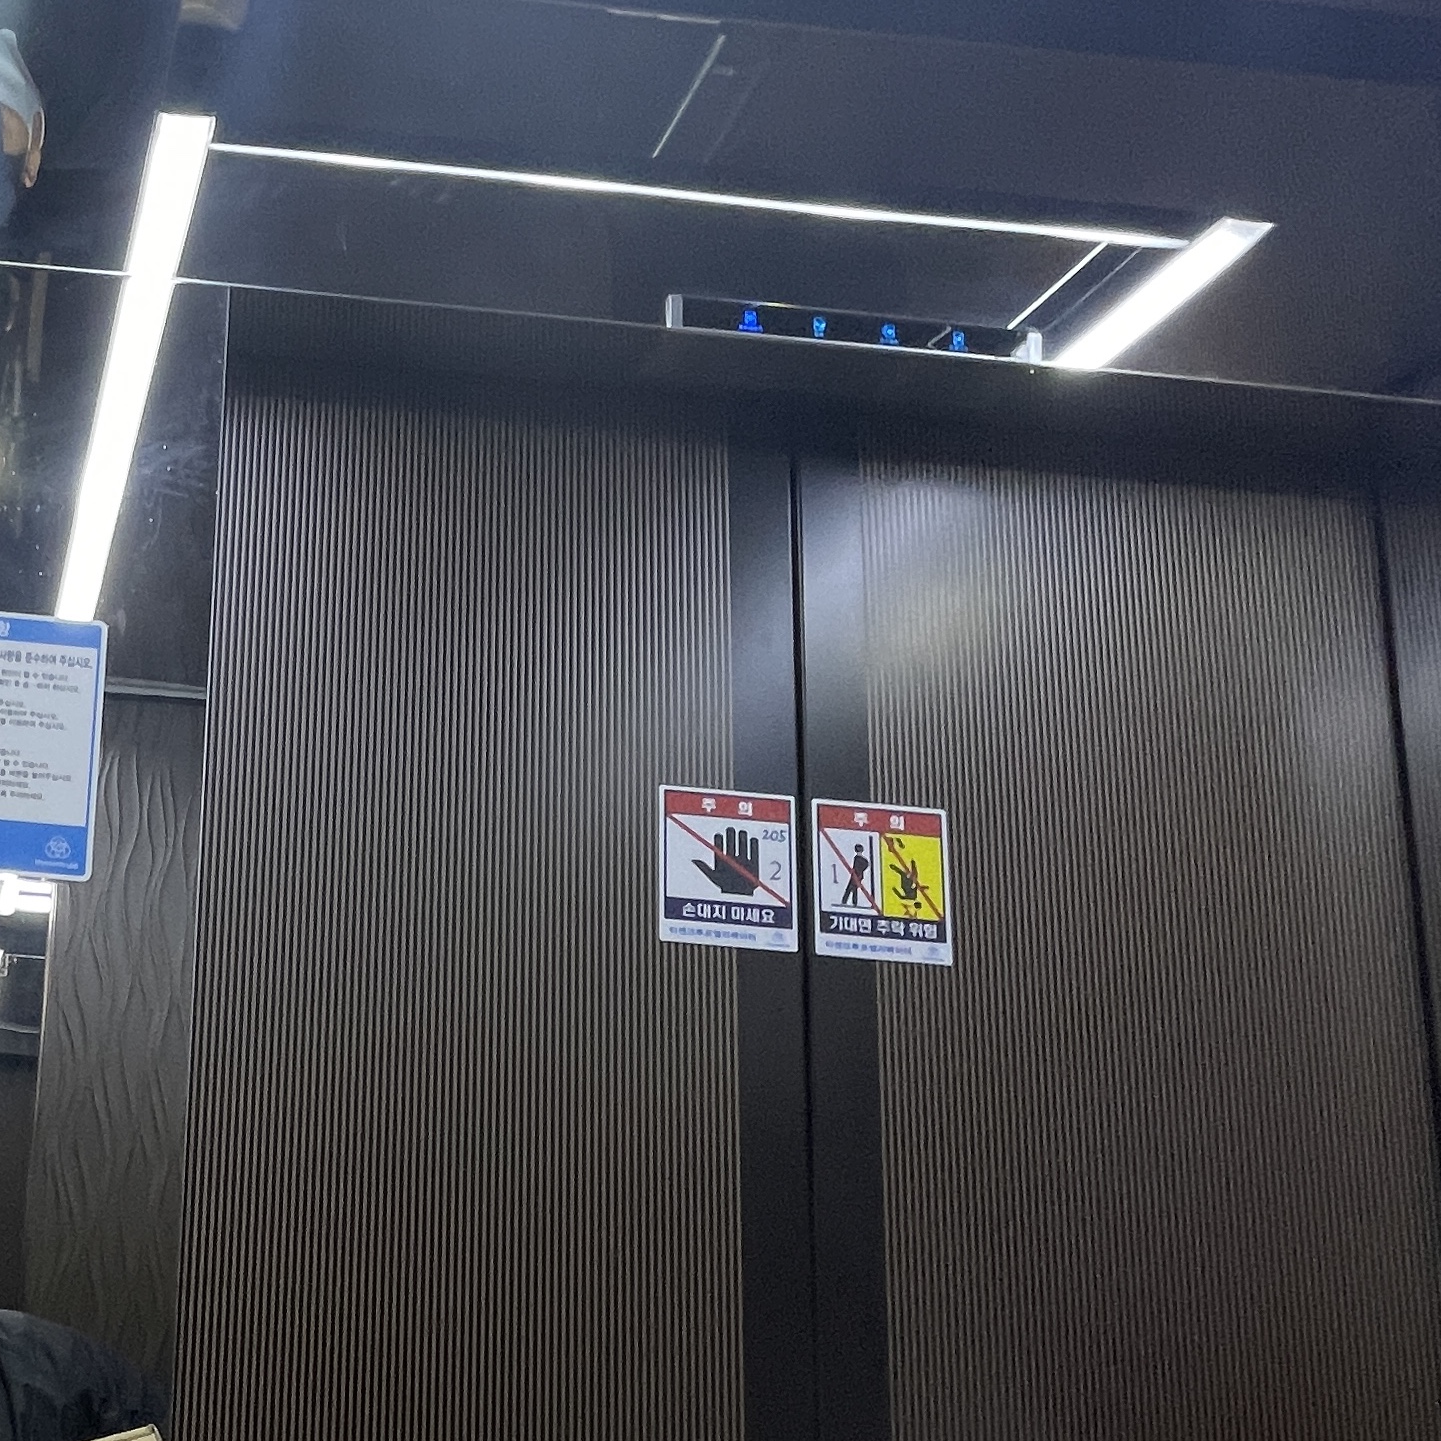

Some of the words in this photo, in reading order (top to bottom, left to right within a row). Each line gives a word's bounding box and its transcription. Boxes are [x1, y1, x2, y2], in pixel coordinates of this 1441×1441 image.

[761, 828, 788, 844] 205
[768, 860, 783, 882] 2
[682, 901, 727, 920] 손대지
[730, 905, 776, 924] 마세요
[829, 915, 873, 934] 기대면
[877, 919, 906, 937] 추락
[908, 922, 938, 940] 위험
